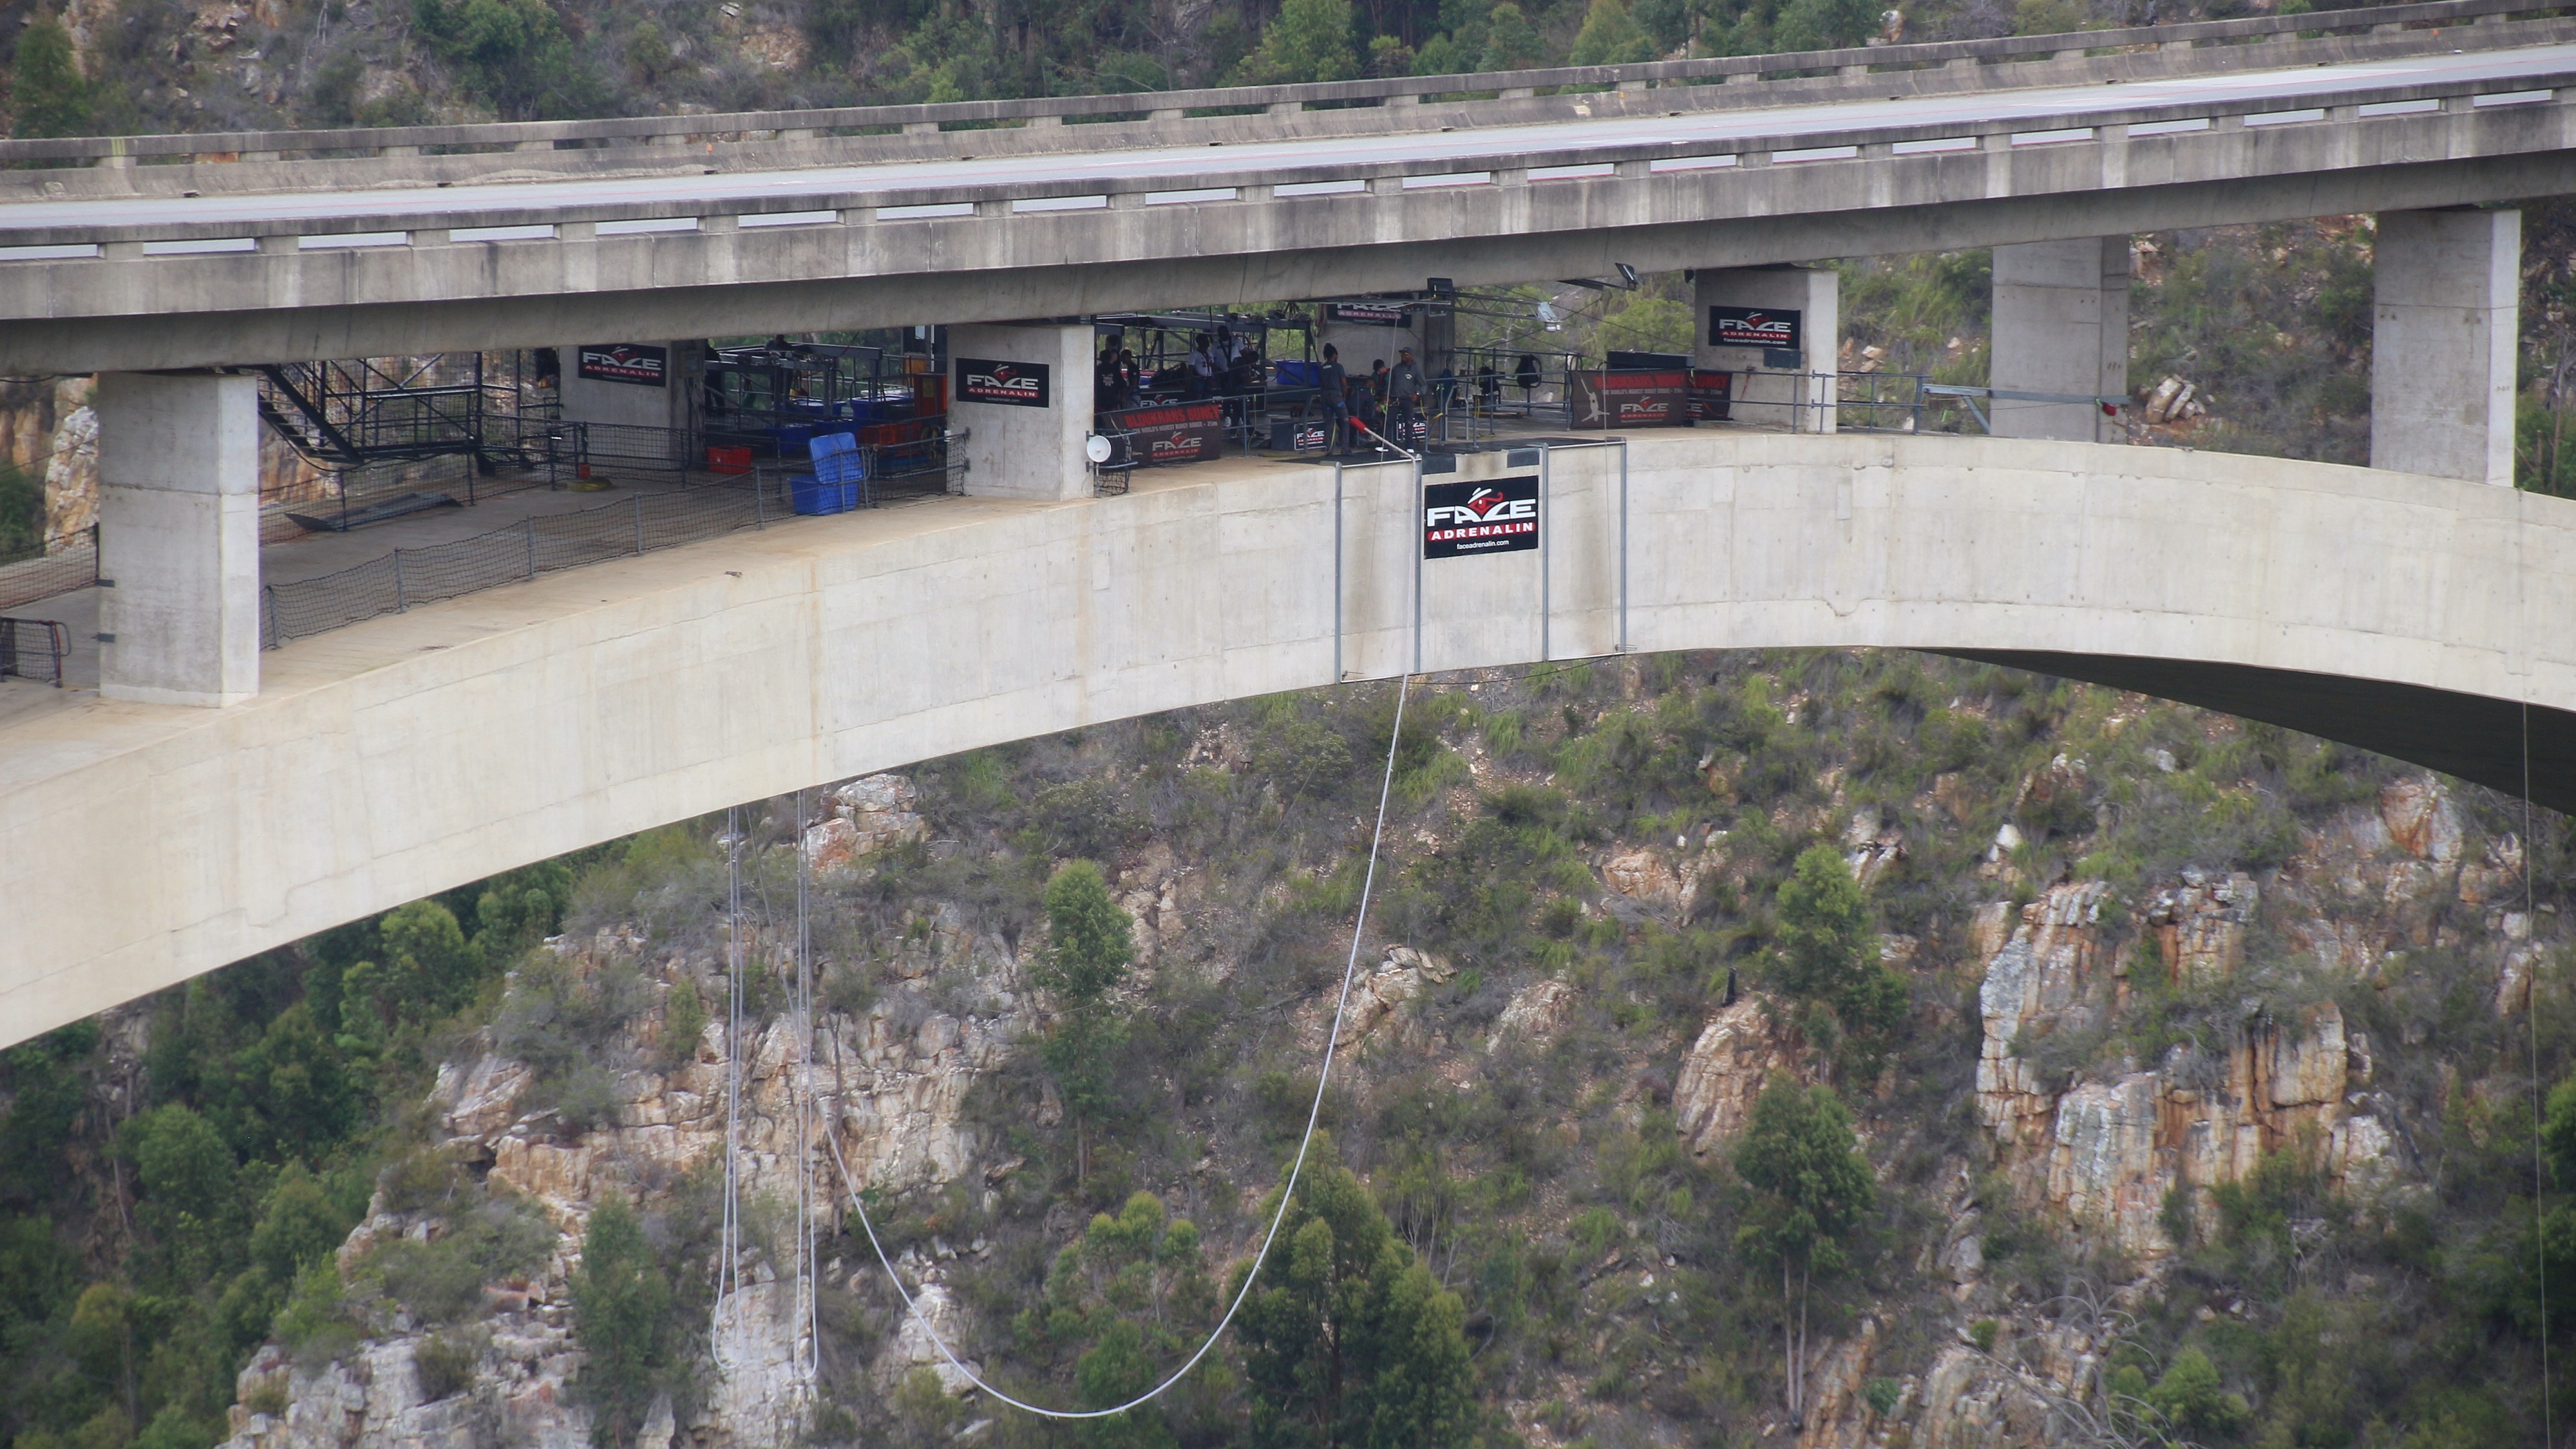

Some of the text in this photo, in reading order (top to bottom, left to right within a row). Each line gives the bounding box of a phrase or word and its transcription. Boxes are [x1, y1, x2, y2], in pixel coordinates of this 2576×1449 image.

[1719, 319, 1791, 332] FACE
[583, 352, 661, 370] FACE
[585, 365, 659, 377] ADRENALIN
[967, 374, 1038, 390] FACE
[969, 388, 1036, 397] ADRENALIN
[1620, 403, 1669, 413] FACE
[1152, 437, 1202, 451] FACE
[1427, 498, 1536, 527] FACE
[1431, 522, 1533, 540] ADRENALIN
[1457, 540, 1510, 550] faceadrenalin.com
